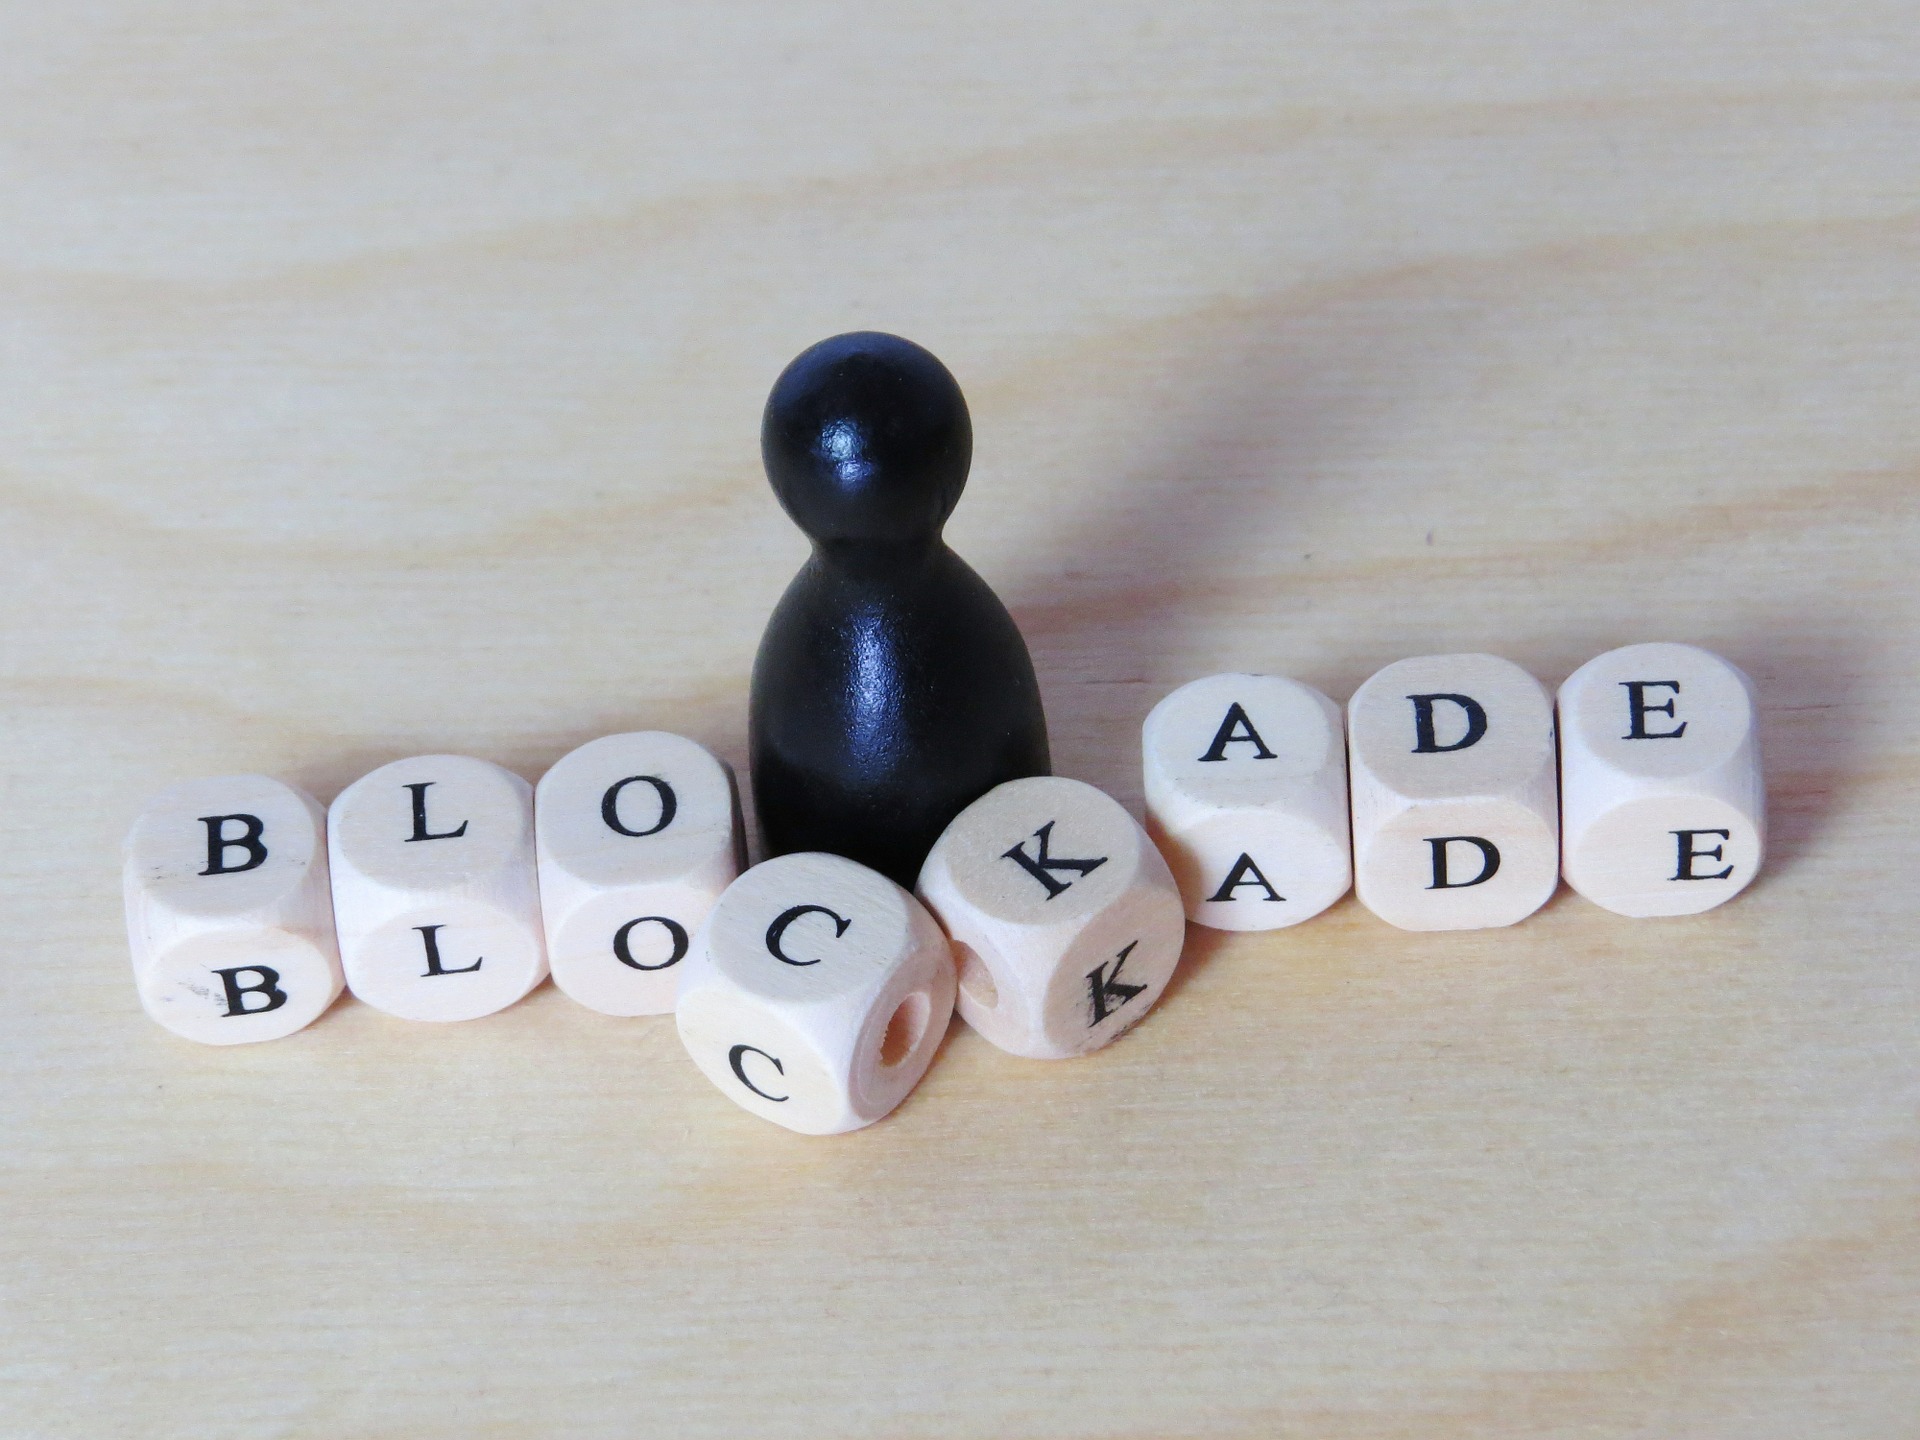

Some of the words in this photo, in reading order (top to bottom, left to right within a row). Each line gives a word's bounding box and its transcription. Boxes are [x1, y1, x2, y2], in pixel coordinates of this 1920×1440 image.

[1198, 702, 1278, 762] A
[1406, 694, 1488, 754] D
[1619, 681, 1688, 740] E
[403, 782, 469, 843] L
[198, 814, 268, 876] B
[1001, 821, 1109, 900] K
[1425, 837, 1501, 890] D
[1669, 829, 1735, 881] E
[1206, 852, 1286, 903] A
[413, 925, 482, 977] L
[766, 905, 852, 967] C
[212, 966, 288, 1018] B
[1086, 940, 1149, 1029] K
[729, 1045, 789, 1102] C
